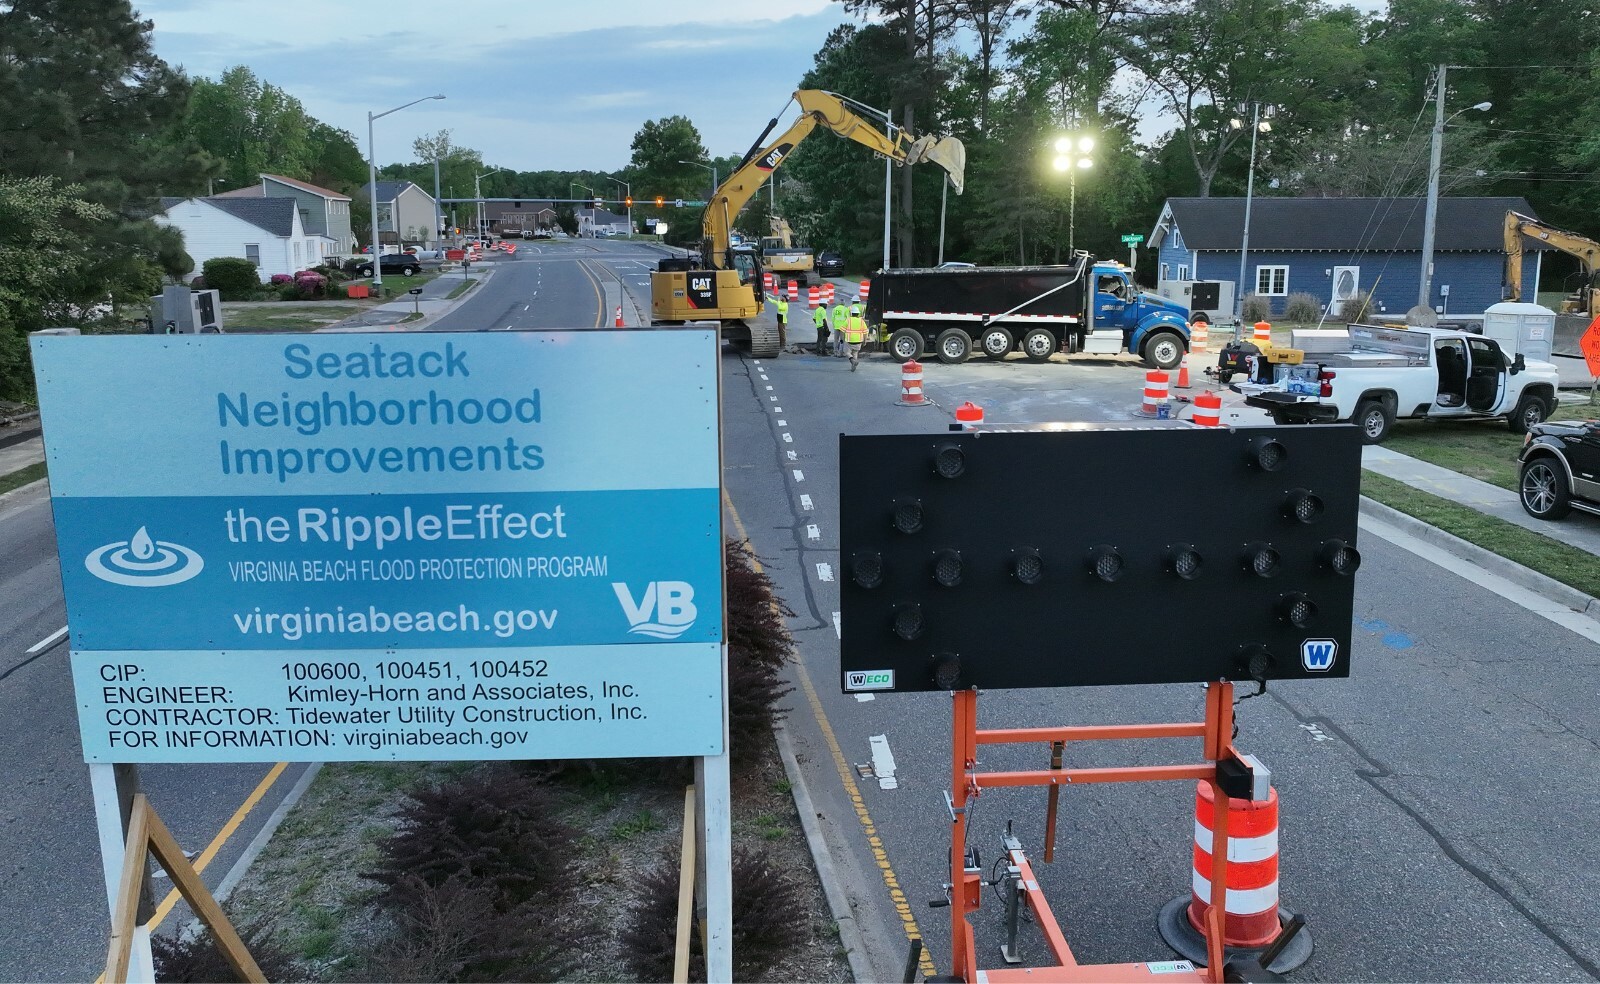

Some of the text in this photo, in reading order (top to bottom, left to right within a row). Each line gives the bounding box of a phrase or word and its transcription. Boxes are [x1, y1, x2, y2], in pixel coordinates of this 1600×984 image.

[766, 148, 784, 167] CAT
[692, 278, 712, 290] CAT
[284, 342, 470, 380] Seatack
[218, 388, 542, 436] Neighborhood
[220, 437, 545, 484] Improvements
[229, 555, 608, 583] VIRGINIA BEACH FLOOD PROTECTION PROGRAM
[611, 580, 698, 627] VB
[234, 603, 558, 641] virginiabeach.gov
[1307, 644, 1332, 665] W
[100, 659, 548, 683] CIP: 100600, 100451, 100452
[103, 680, 639, 707] ENGINEER: Kimley-Horn and Associates, Inc.
[106, 702, 648, 728] CONTRACTOR: Tidewater Utility Construction, Inc.
[109, 727, 529, 750] FOR INFORMATION: virginiabeach.gov
